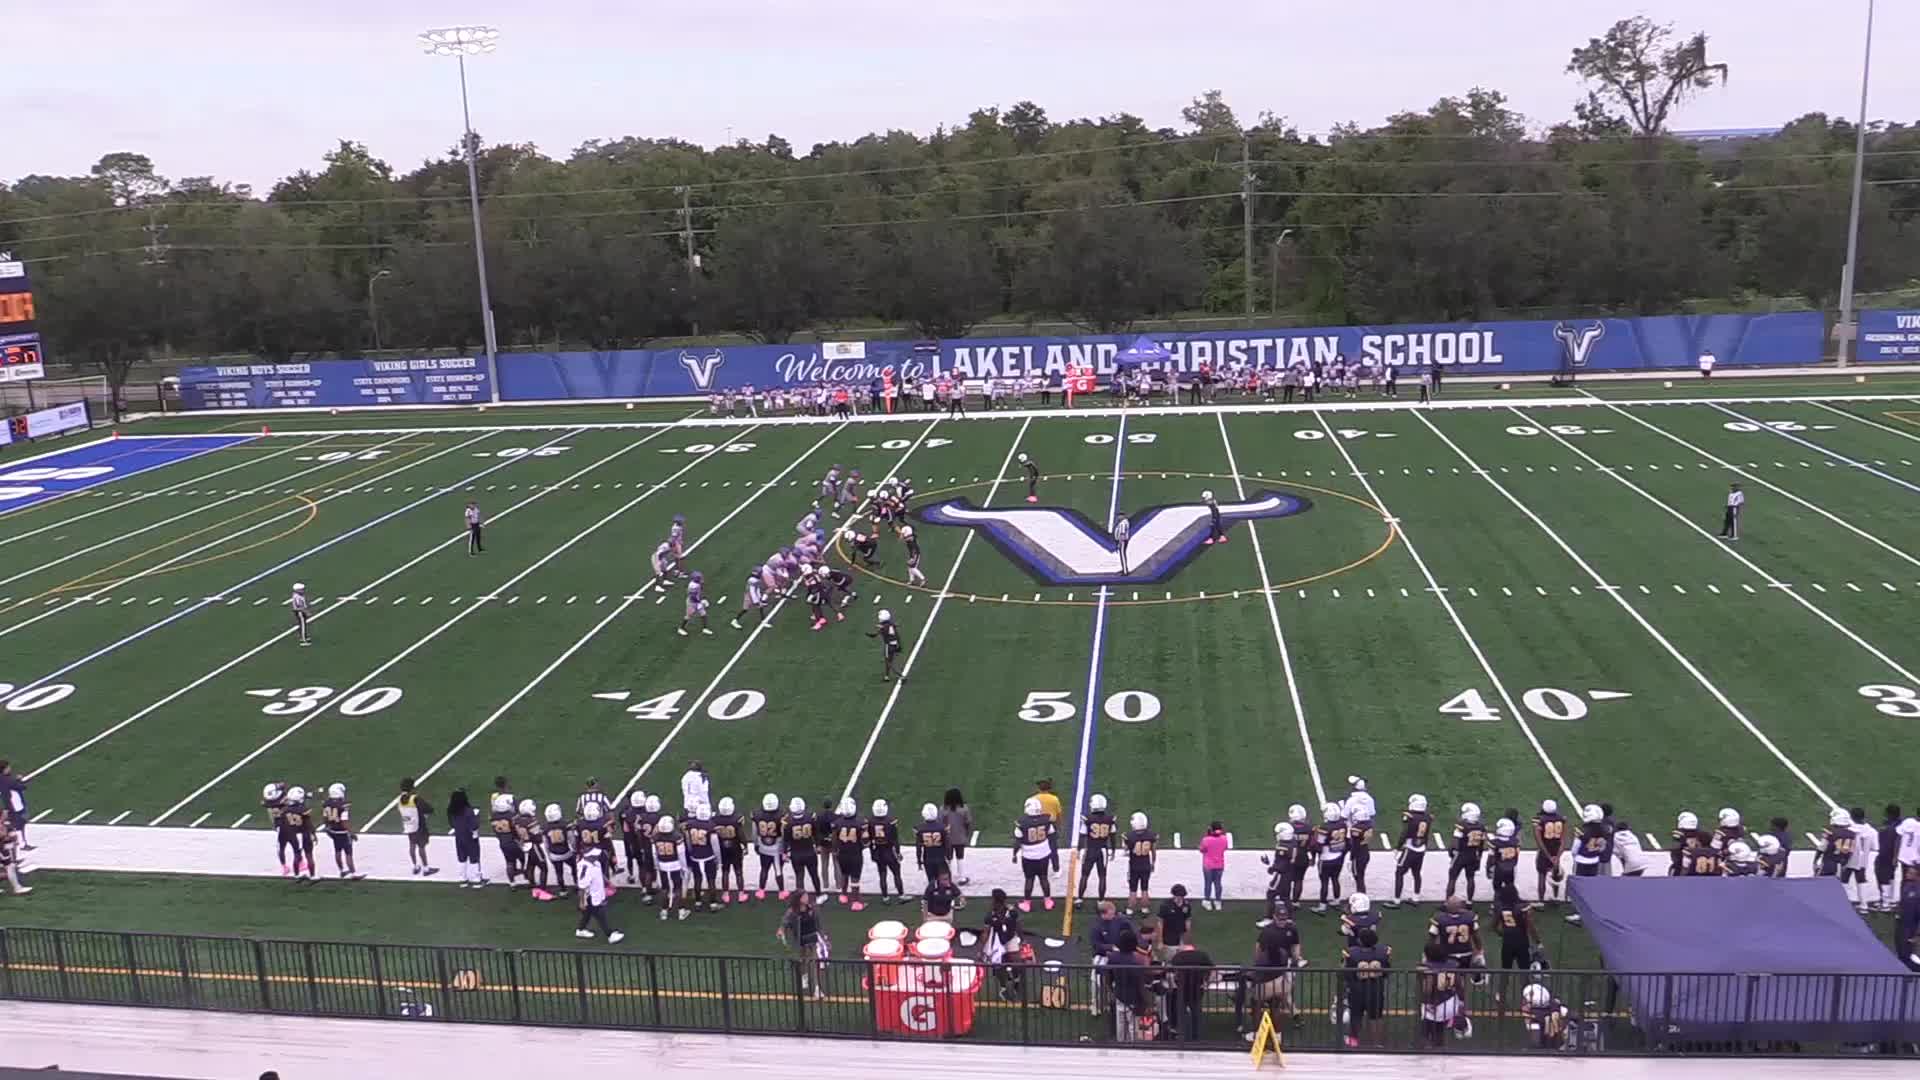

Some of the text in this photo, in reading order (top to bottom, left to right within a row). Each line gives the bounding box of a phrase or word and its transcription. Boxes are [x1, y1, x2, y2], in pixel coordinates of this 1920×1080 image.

[374, 358, 475, 371] VIKING GIRLS SOCCER
[775, 352, 925, 383] Welcome to
[932, 343, 1119, 378] LAKELAND
[1362, 330, 1503, 367] SCHOOL
[216, 366, 249, 376] VIKING
[261, 686, 403, 716] 30
[626, 689, 766, 720] 40
[1018, 690, 1161, 722] 50
[1438, 687, 1588, 720] 40
[838, 827, 858, 843] 44
[900, 995, 937, 1032] G
